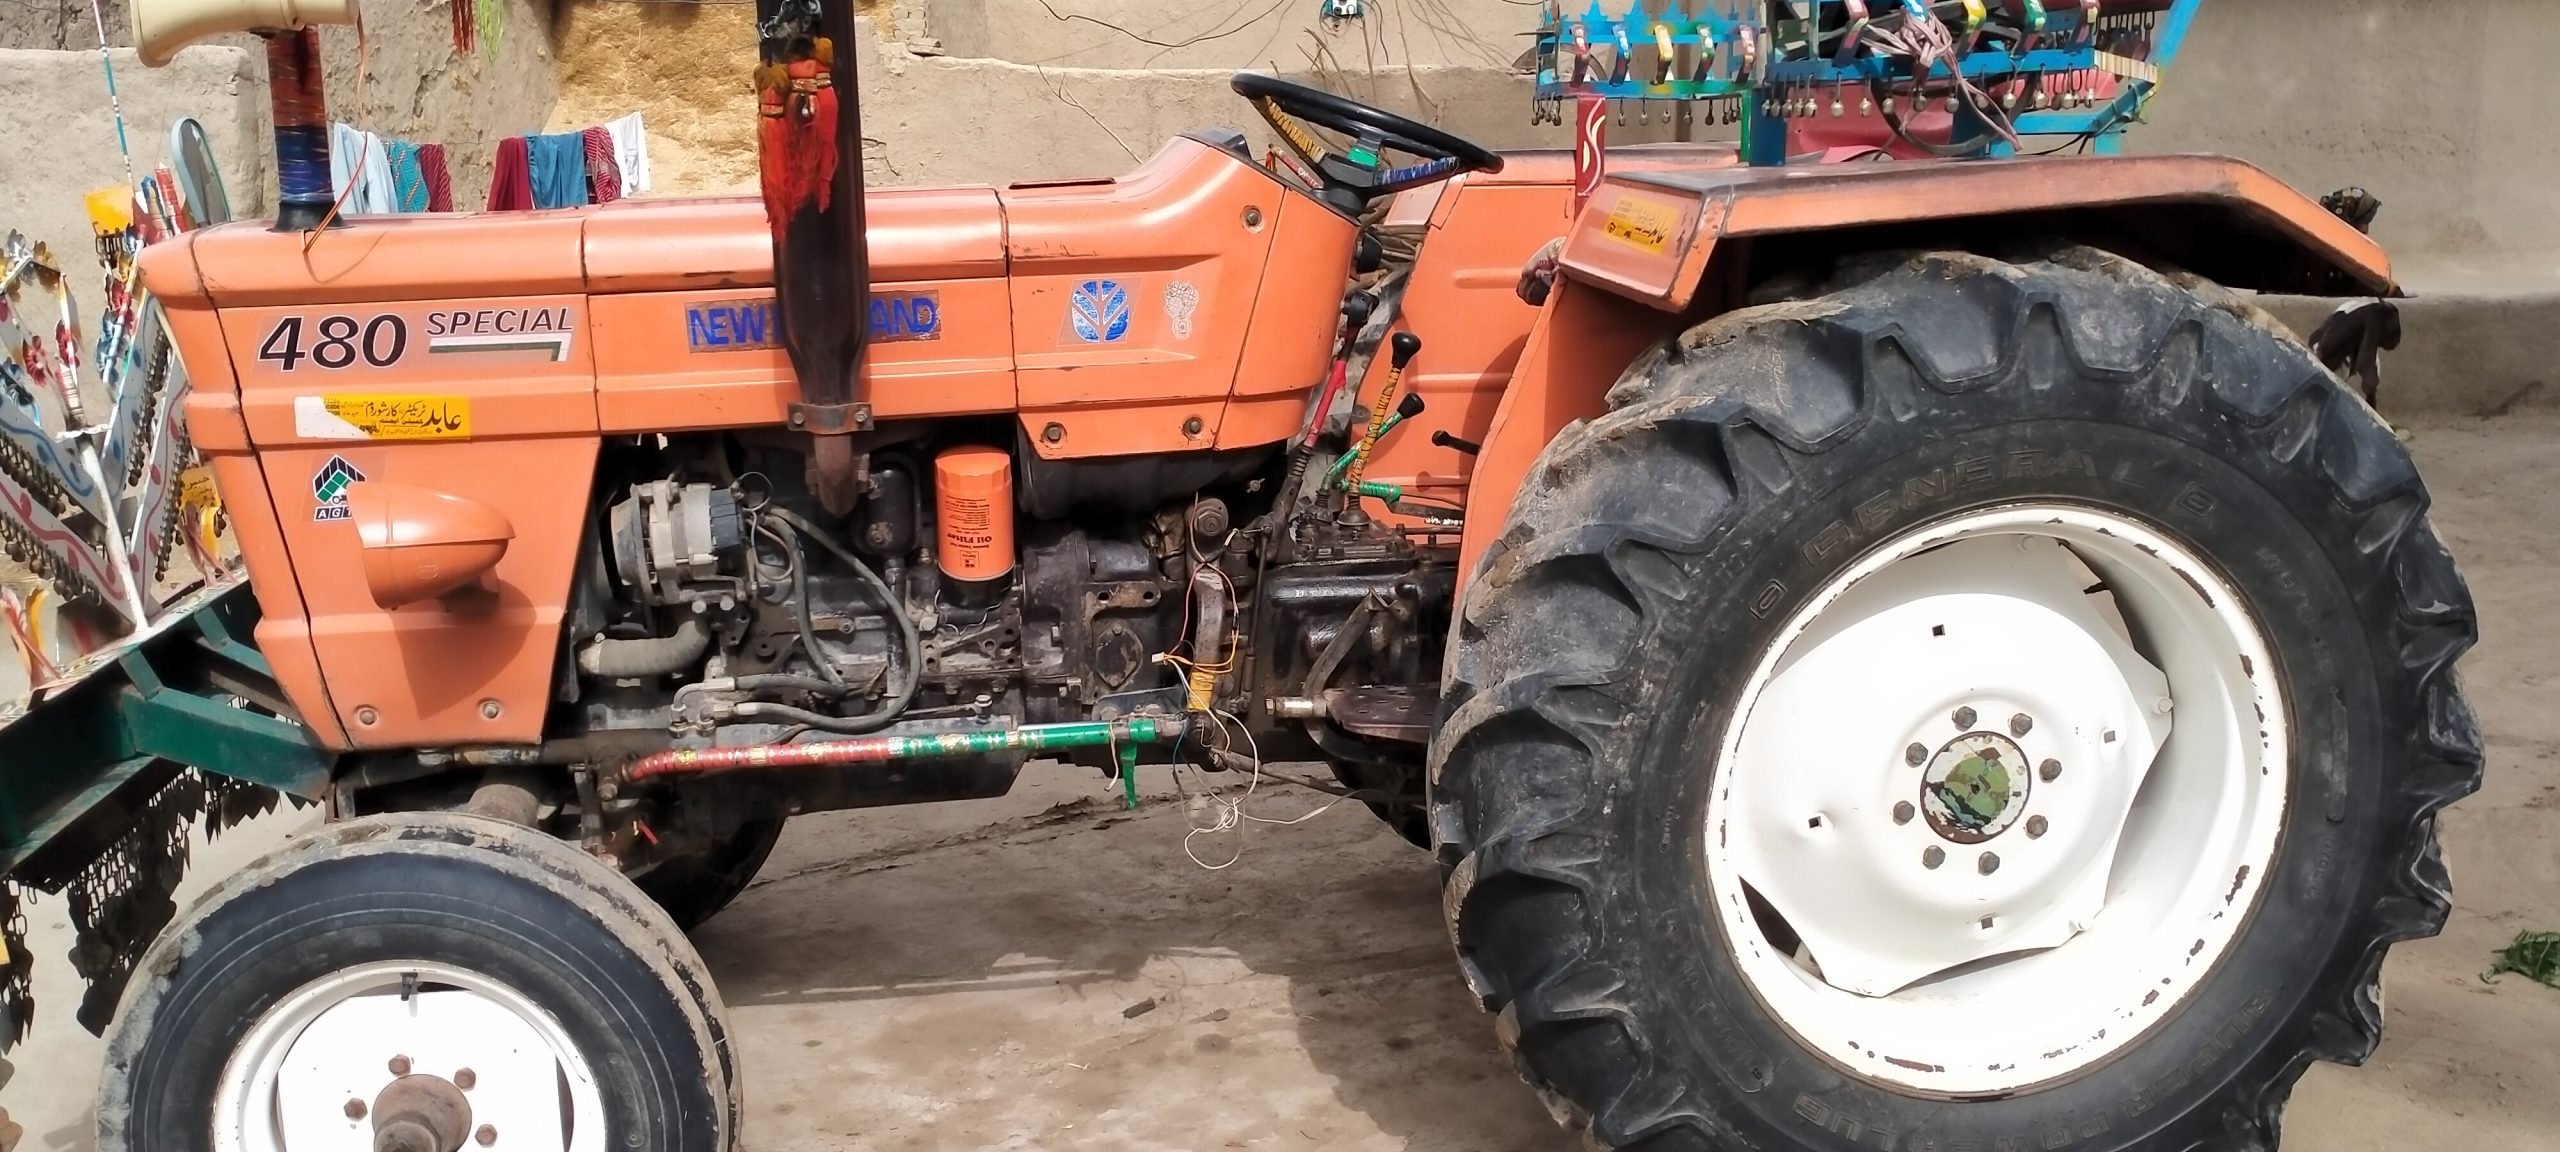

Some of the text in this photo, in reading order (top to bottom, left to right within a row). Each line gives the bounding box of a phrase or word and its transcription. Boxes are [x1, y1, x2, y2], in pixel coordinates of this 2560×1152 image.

[258, 307, 573, 372] 480 SPECIAL
[688, 304, 766, 346] NEW
[421, 401, 461, 433] عابد
[316, 507, 352, 520] AGT
[1801, 450, 2146, 567] GENERAL
[947, 533, 973, 543] Filter
[2120, 985, 2273, 1118] SUPER
